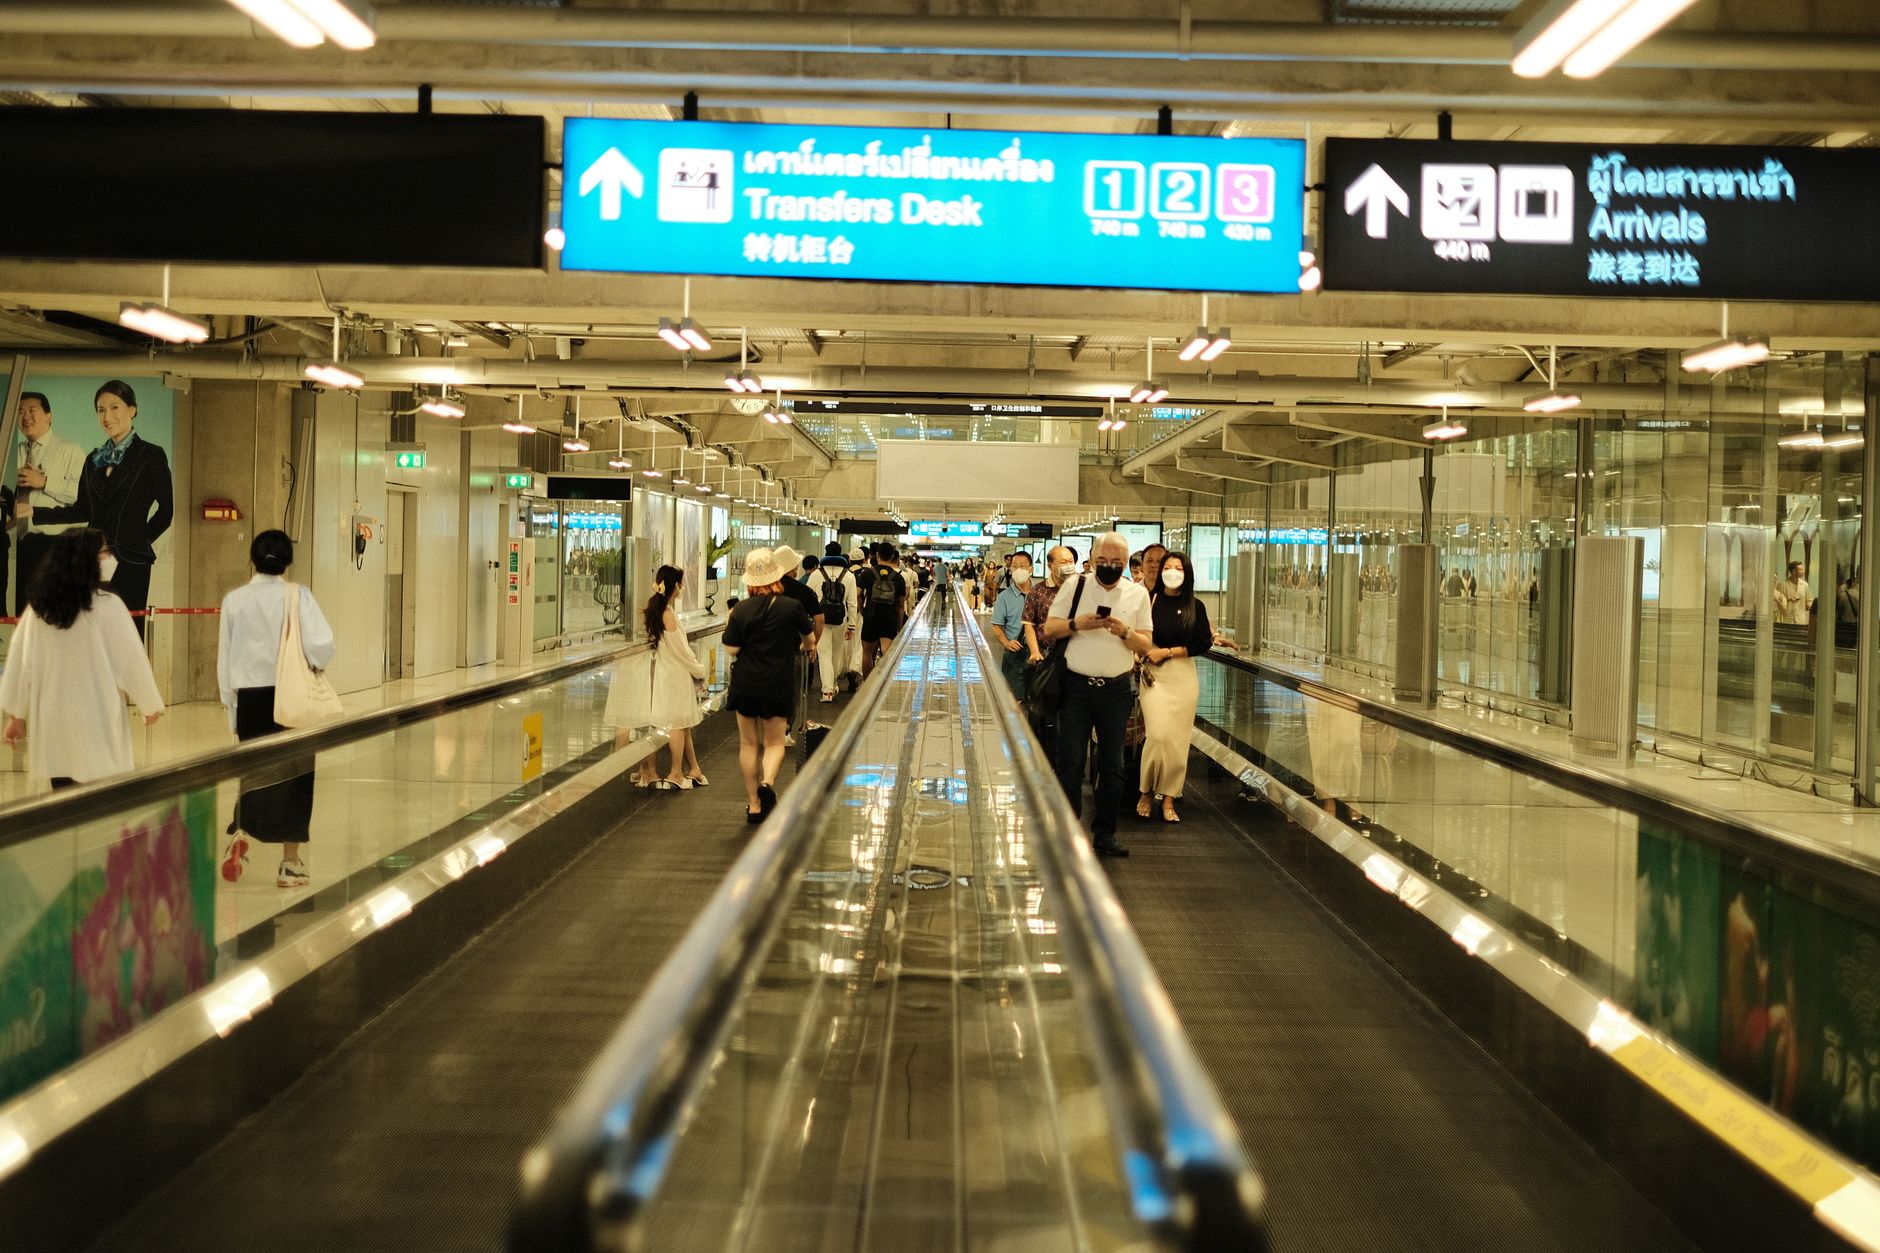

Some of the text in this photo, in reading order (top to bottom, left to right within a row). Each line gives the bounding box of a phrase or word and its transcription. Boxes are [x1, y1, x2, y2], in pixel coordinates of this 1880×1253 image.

[1102, 170, 1259, 213] 1 2 3
[1587, 154, 1796, 207] ผู้โดยสารขาเข้า
[743, 187, 983, 226] Transfers Desk
[1588, 205, 1708, 244] Arrivals
[1470, 241, 1490, 262] m
[1588, 249, 1701, 286] 旅客到达
